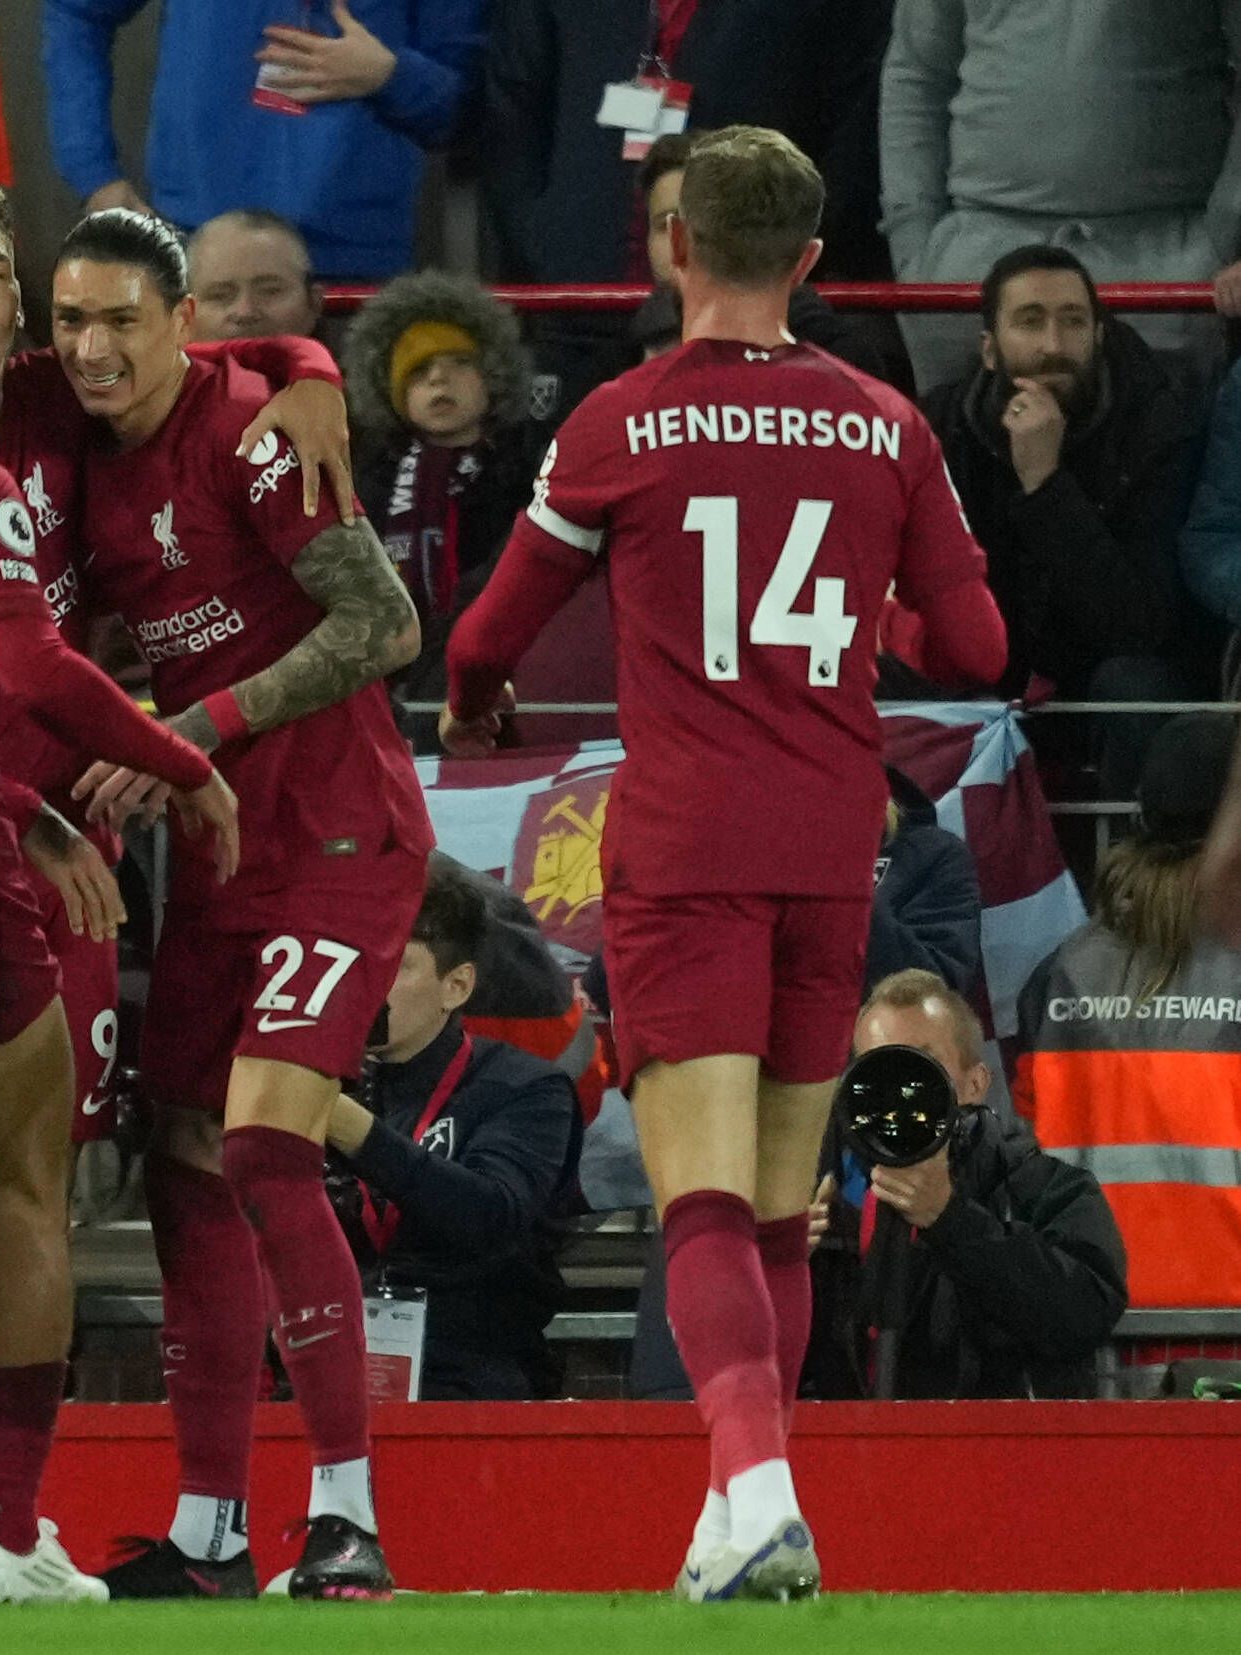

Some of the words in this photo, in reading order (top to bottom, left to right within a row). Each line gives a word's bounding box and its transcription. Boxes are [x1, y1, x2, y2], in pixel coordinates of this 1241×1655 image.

[626, 404, 902, 461] HENDERSON
[249, 446, 300, 504] exped
[137, 595, 227, 643] standard
[682, 495, 858, 689] 14
[253, 934, 361, 1018] 27
[91, 1008, 118, 1088] 9
